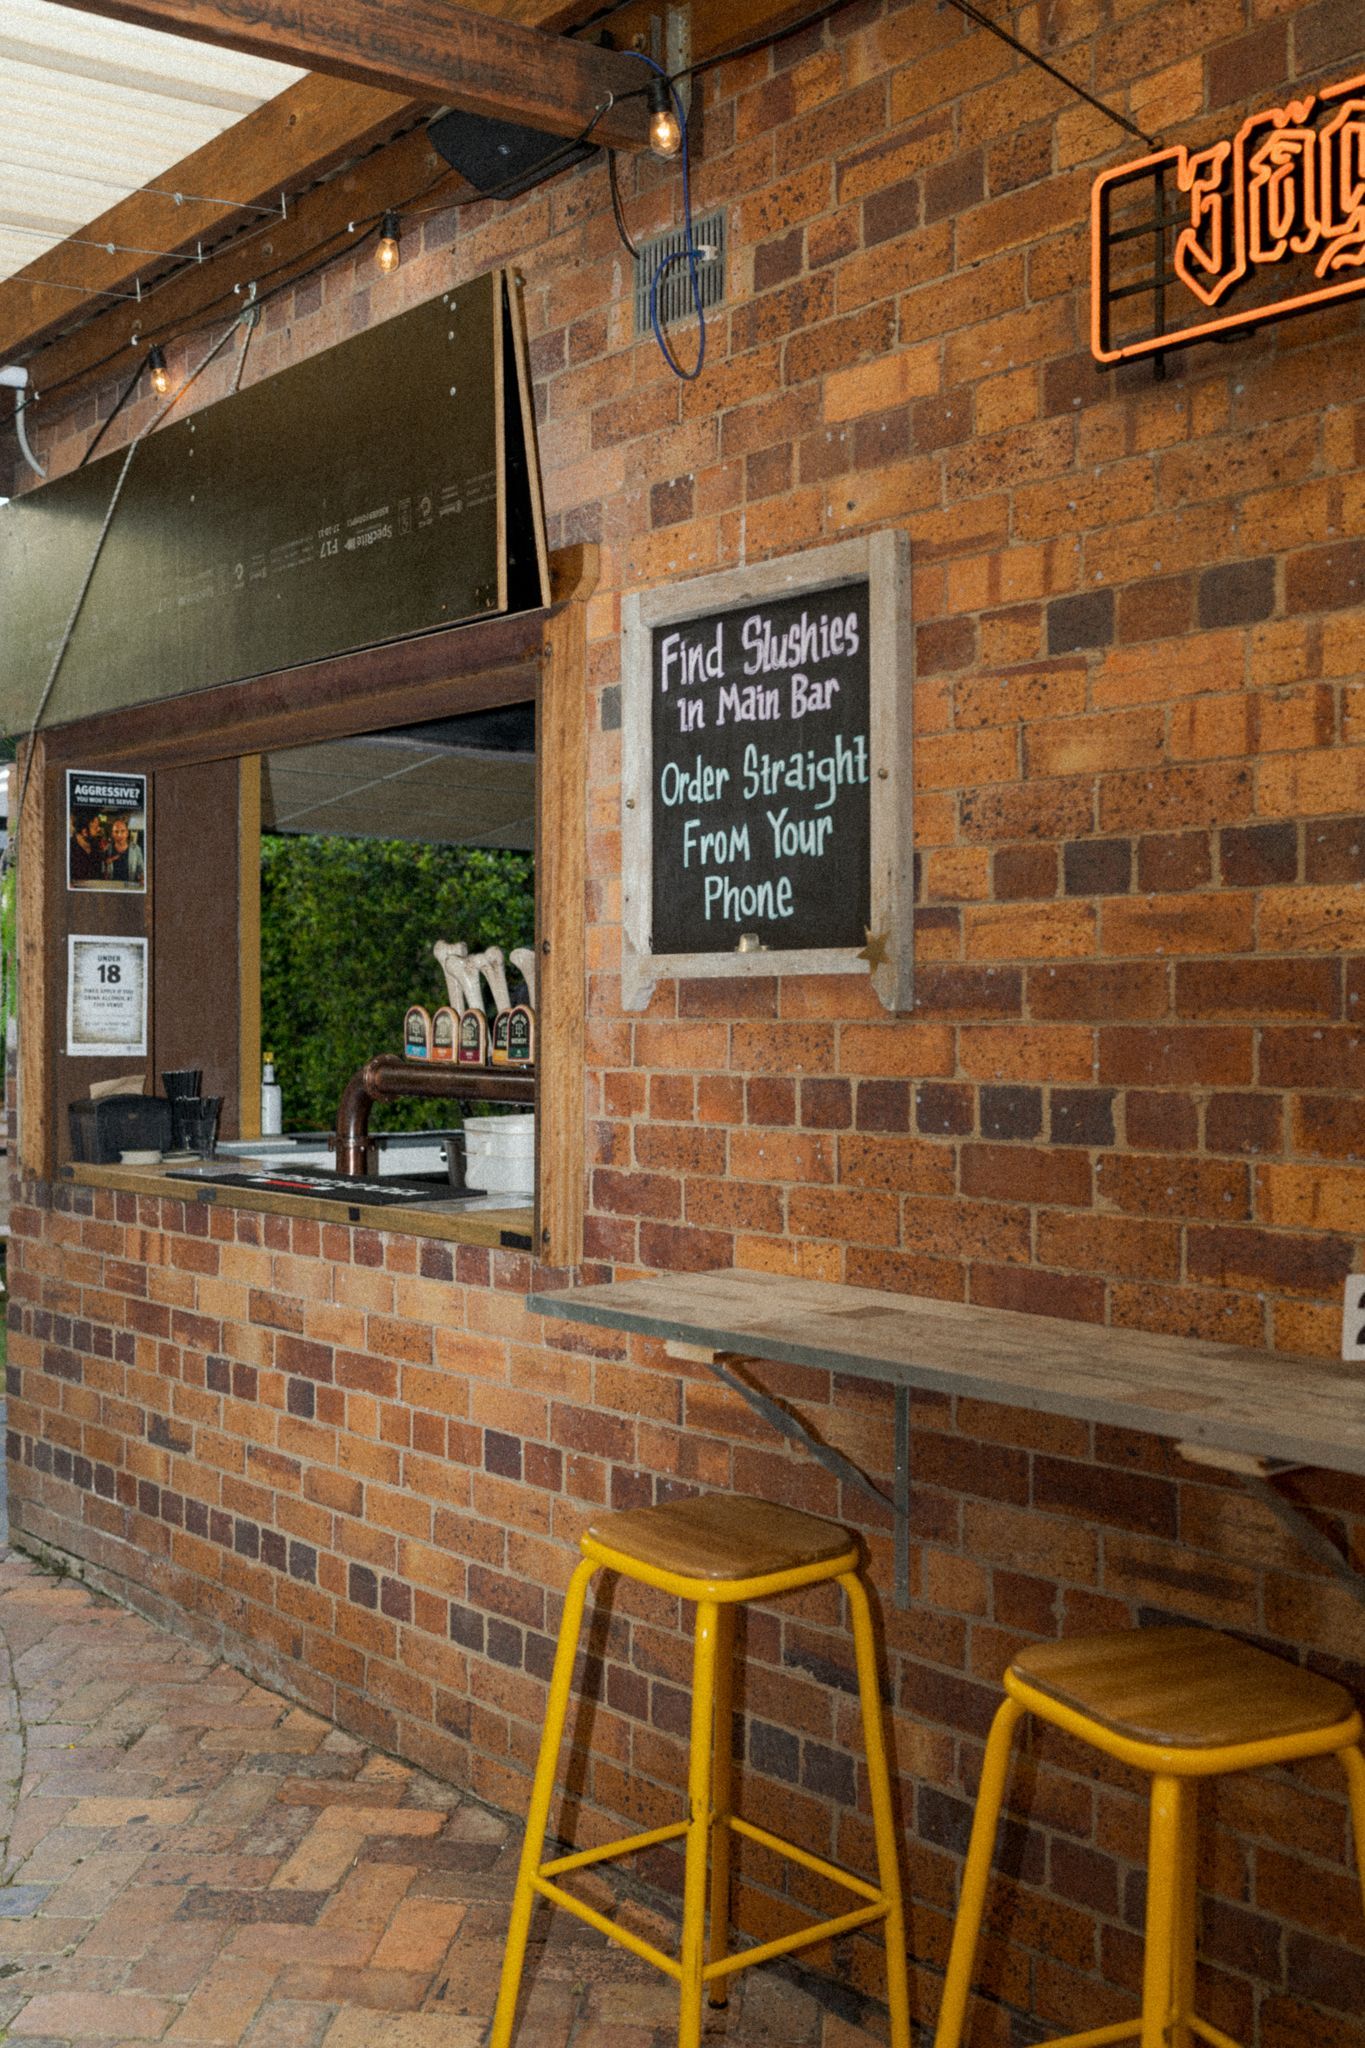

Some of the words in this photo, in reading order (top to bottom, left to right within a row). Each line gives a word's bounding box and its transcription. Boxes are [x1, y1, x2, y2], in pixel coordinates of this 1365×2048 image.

[320, 538, 339, 558] F17
[660, 621, 725, 693] Find
[741, 612, 860, 676] Slushies
[717, 682, 781, 727] Main
[791, 673, 840, 720] Bar
[74, 784, 140, 799] AGGRESSIVE?
[661, 755, 730, 806] Order
[743, 735, 869, 810] Straight
[766, 807, 833, 861] Your
[704, 875, 795, 922] Phone
[97, 964, 121, 983] 18
